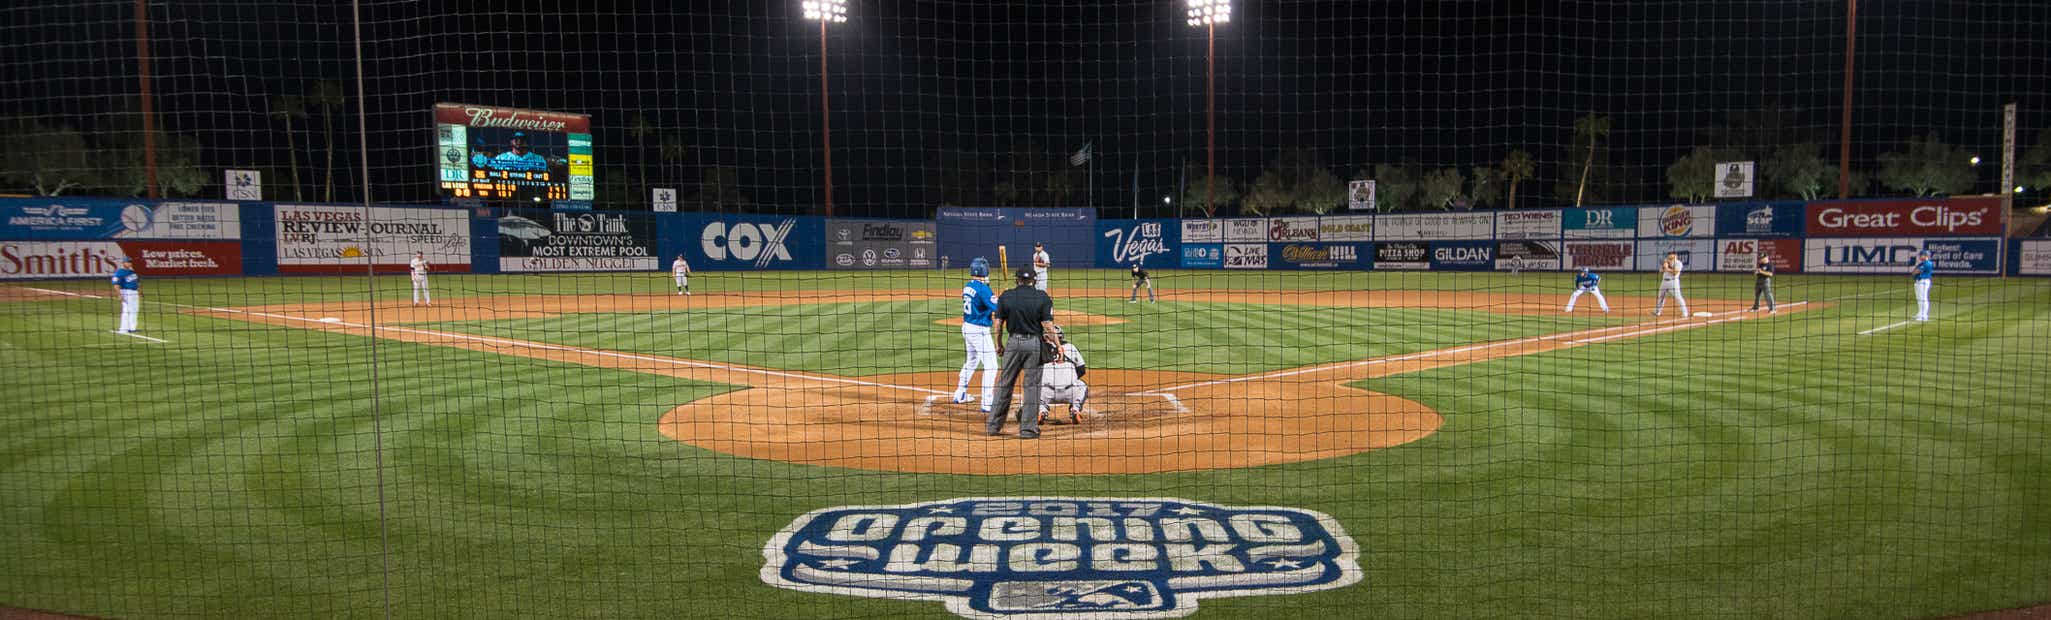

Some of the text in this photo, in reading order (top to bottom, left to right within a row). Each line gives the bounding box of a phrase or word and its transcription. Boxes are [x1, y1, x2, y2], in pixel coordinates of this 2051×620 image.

[465, 107, 567, 132] Budweiser
[9, 216, 104, 225] AMERICA FIRST
[282, 211, 361, 222] LAS VEGAS
[554, 213, 628, 233] The Tank
[1585, 209, 1614, 225] DR
[1663, 210, 1690, 223] BURGER
[1818, 206, 1984, 232] Great Clips
[862, 223, 903, 238] Findlay
[1321, 223, 1370, 233] GOLD COAST
[1663, 218, 1691, 234] KING
[411, 234, 442, 244] SPEED
[549, 234, 632, 246] DOWNTOWN'S
[701, 217, 796, 268] COX
[1105, 225, 1170, 265] Vegas
[142, 248, 205, 260] Low prices.
[533, 246, 648, 257] MOST EXTREME POOL
[1329, 245, 1358, 260] HILL
[1379, 248, 1402, 258] PIZZA
[1435, 247, 1490, 261] GILDAN
[1725, 241, 1754, 254] AIS
[1928, 243, 1960, 253] Highest
[1, 243, 118, 275] Smith's
[1824, 245, 1917, 266] UMC
[1932, 252, 1984, 260] evel of Care
[146, 258, 218, 269] Market fresh.
[589, 257, 640, 269] NUGGET
[1938, 261, 1973, 269] Nevada.
[971, 501, 1163, 517] 2017
